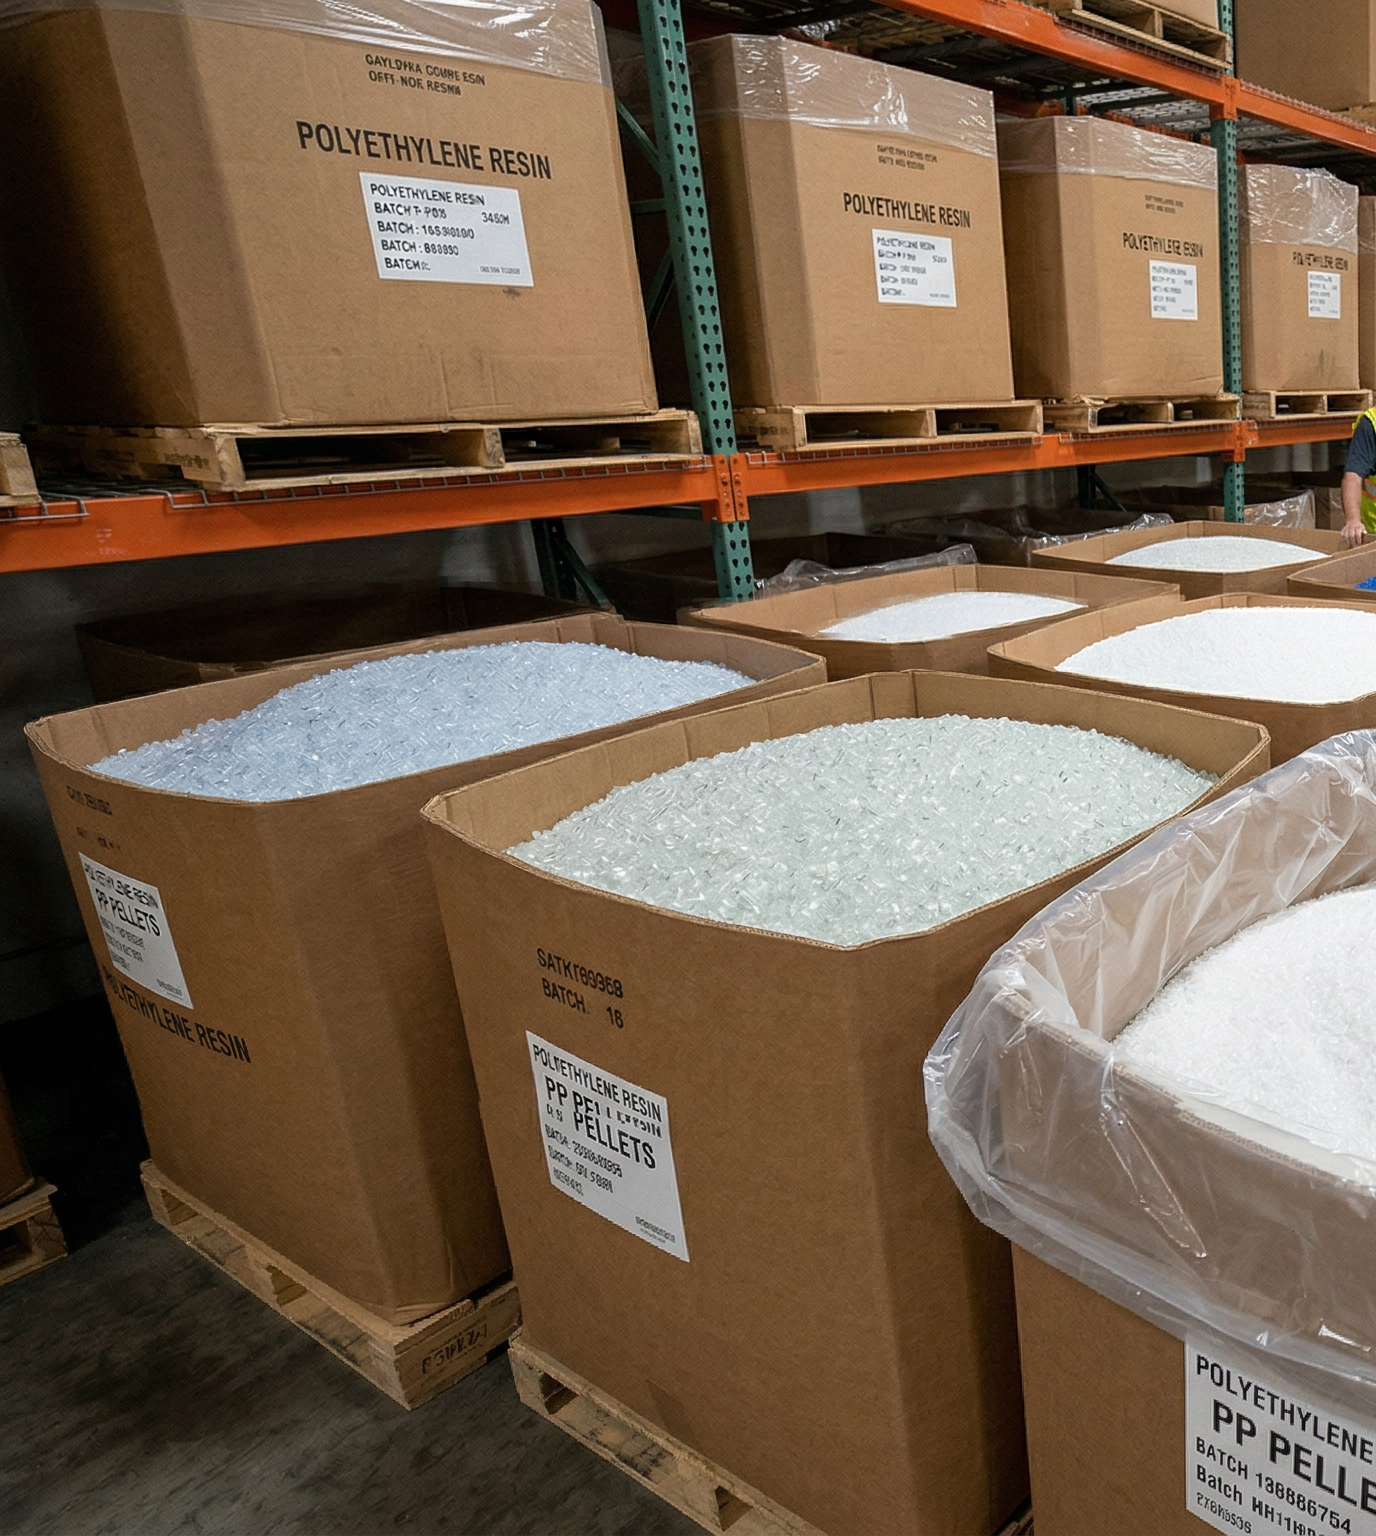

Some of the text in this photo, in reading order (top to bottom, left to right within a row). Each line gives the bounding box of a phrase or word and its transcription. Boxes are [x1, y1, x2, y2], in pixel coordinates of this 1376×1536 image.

[296, 120, 552, 180] POLYETHYLENE RESIN
[370, 183, 485, 206] POLYETHYLENE RESIN
[374, 202, 411, 216] BATCH
[843, 192, 971, 229] POLYETHYLENE RESIN
[109, 896, 161, 937] PELLETS
[194, 1022, 252, 1064] RESIN
[545, 1075, 568, 1106] PP
[622, 1088, 662, 1122] RESIN
[573, 1110, 656, 1169] PELLETS
[1196, 1354, 1374, 1465] POLYETHYLENE
[1212, 1399, 1257, 1446] PP
[1197, 1436, 1248, 1480] BATCH
[1197, 1464, 1243, 1505] Batch
